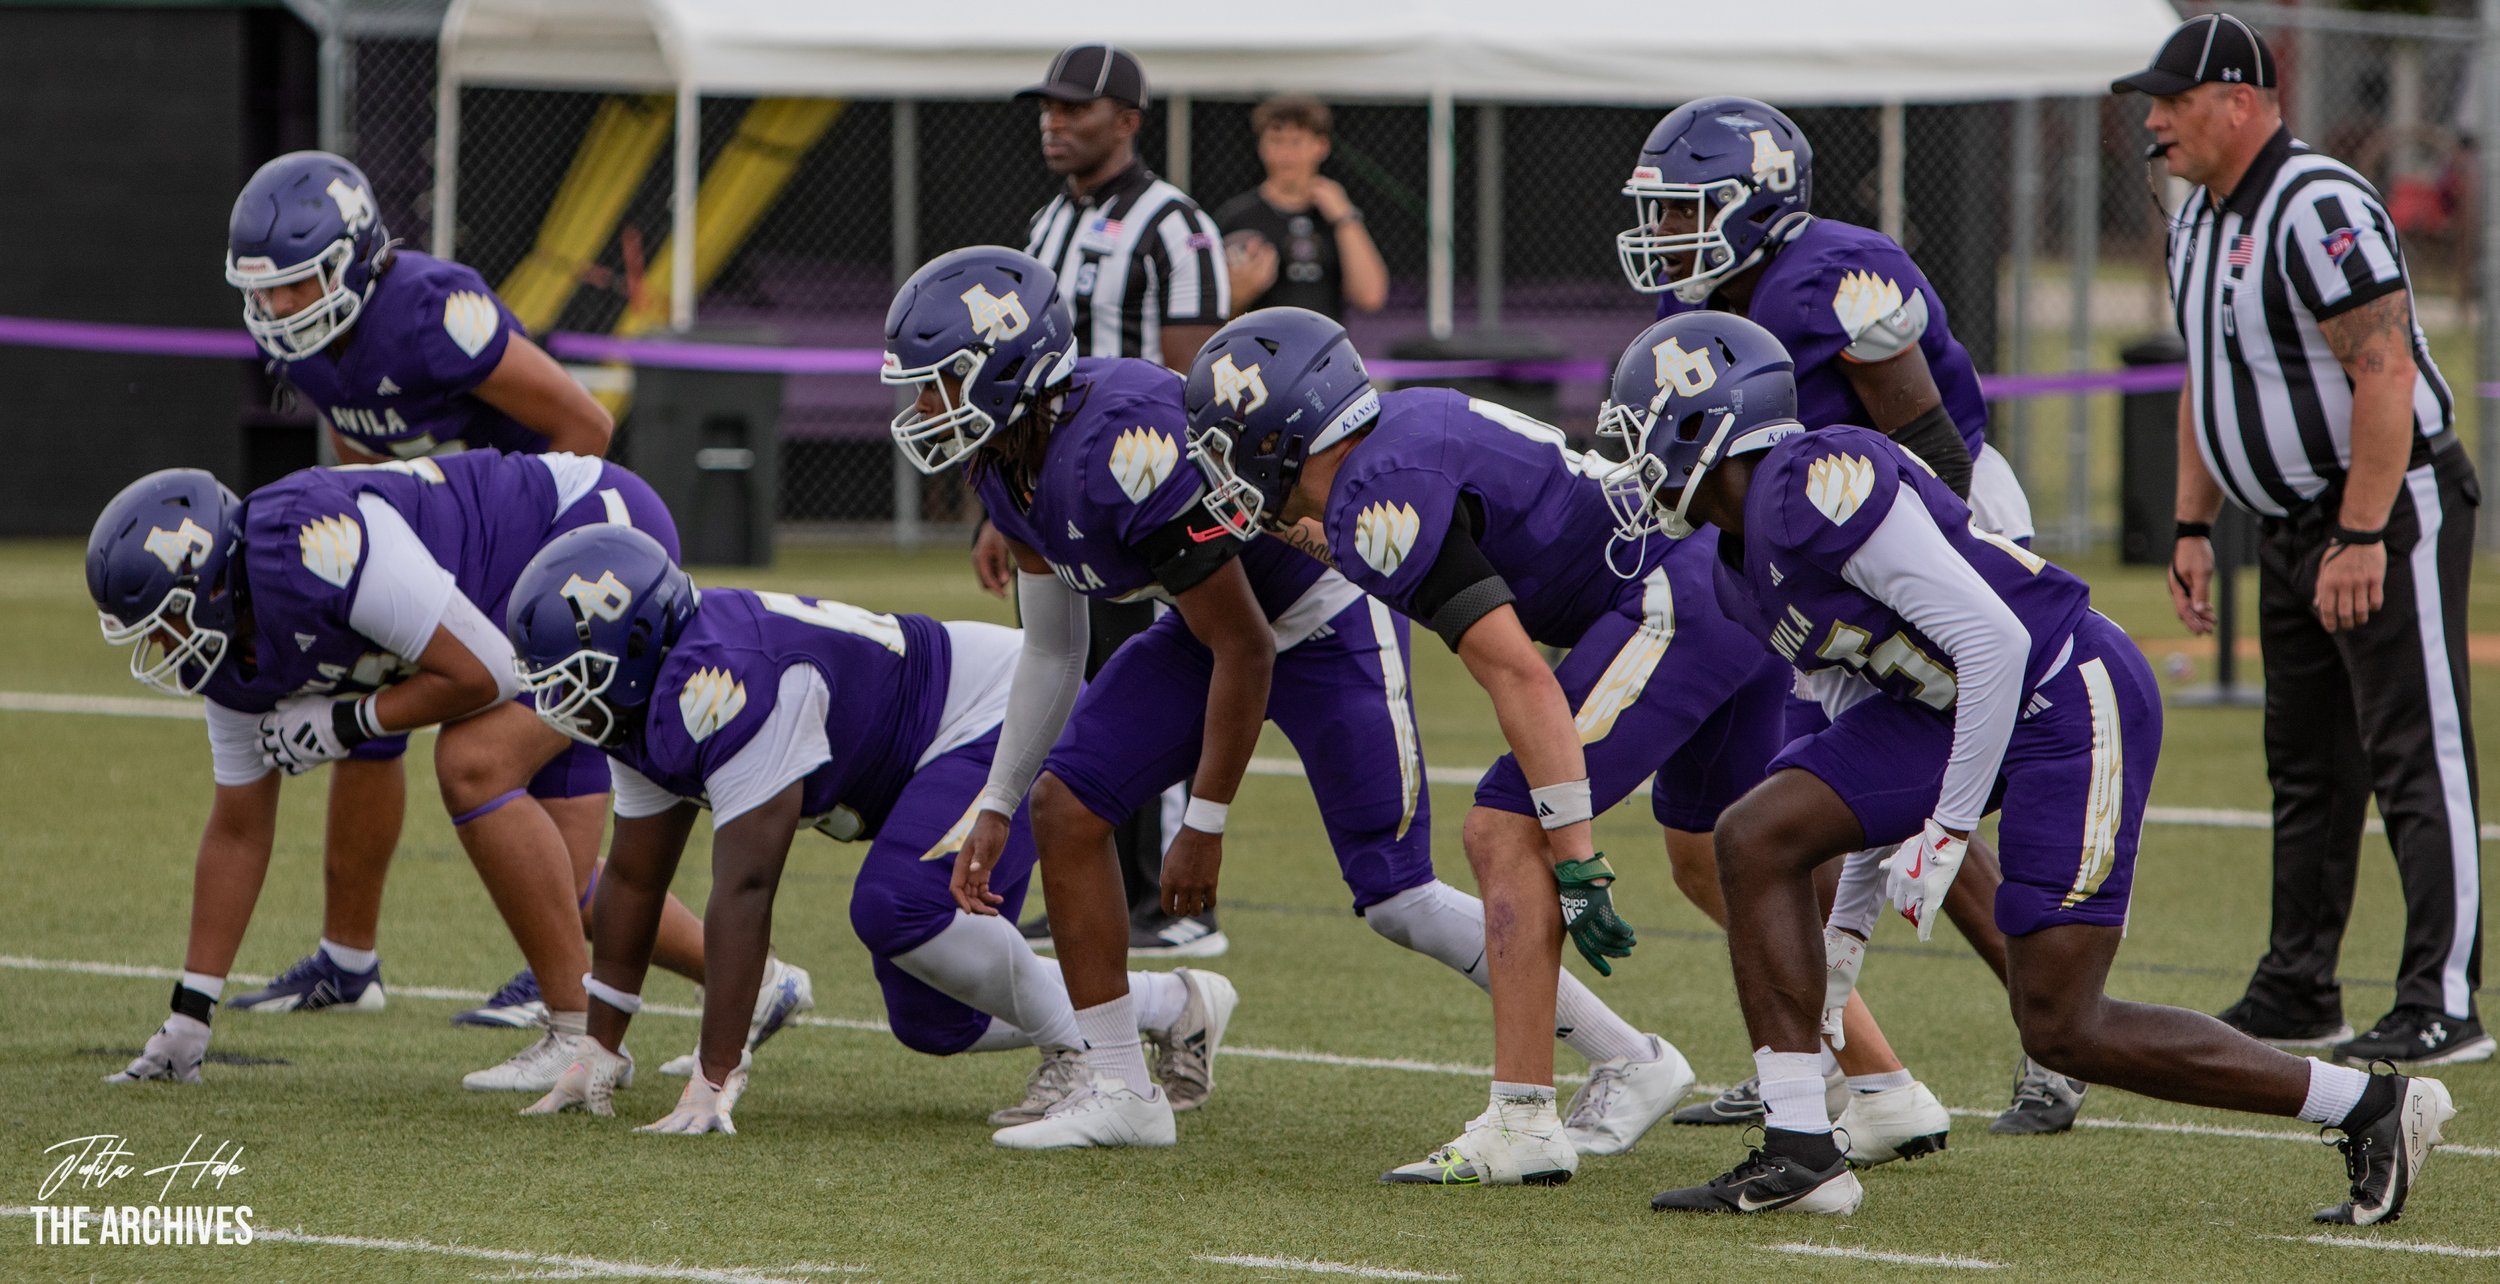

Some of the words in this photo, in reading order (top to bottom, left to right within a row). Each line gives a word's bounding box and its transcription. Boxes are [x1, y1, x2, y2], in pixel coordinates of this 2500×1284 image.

[1750, 129, 1796, 193] AU
[960, 283, 1031, 342] AU
[1211, 353, 1269, 416] AU
[1652, 336, 1717, 398] AU
[330, 406, 409, 436] AVILA
[143, 517, 213, 574] AU
[559, 569, 632, 623] AU
